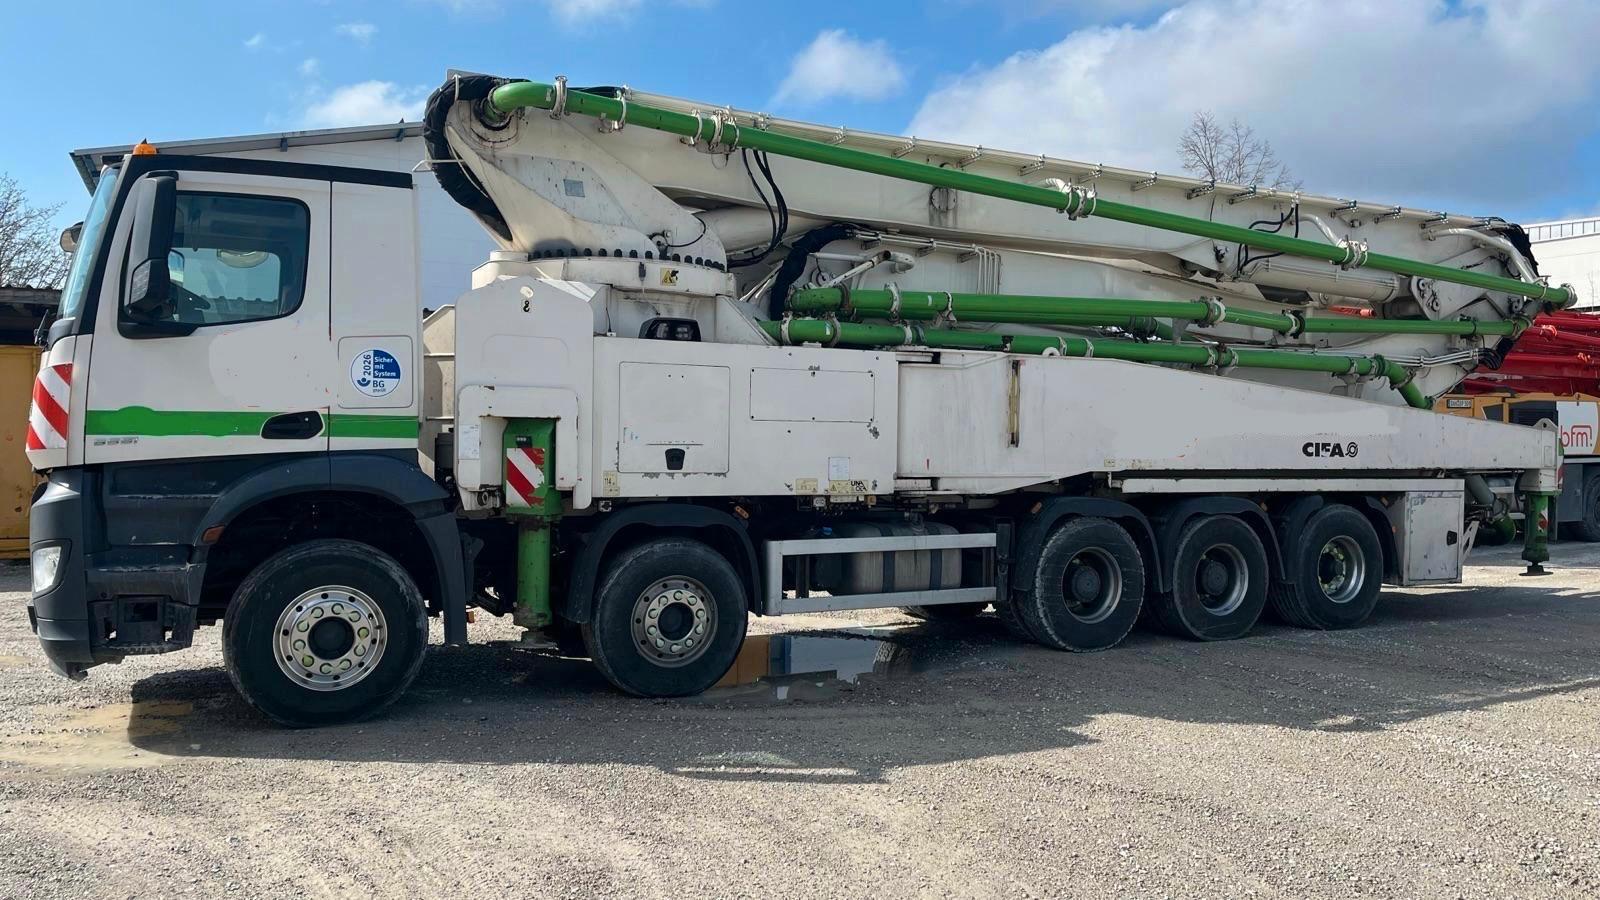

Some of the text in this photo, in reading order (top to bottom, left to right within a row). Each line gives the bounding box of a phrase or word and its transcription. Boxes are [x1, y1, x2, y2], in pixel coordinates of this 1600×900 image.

[363, 354, 372, 376] 2026
[373, 380, 385, 388] BG
[1301, 442, 1345, 457] CIFA
